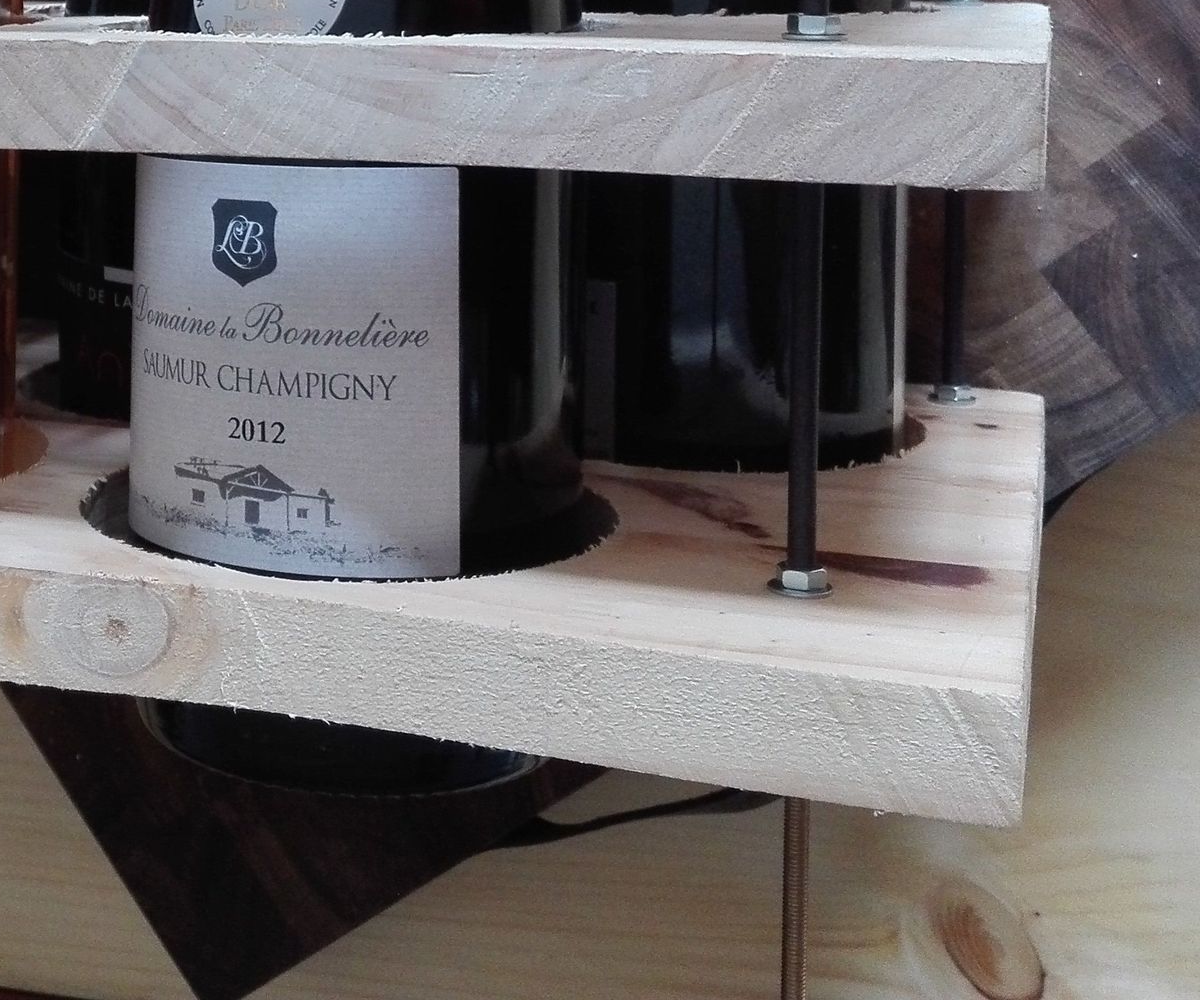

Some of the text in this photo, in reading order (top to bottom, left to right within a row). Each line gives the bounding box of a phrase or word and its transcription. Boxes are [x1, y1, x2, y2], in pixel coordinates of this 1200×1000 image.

[135, 283, 431, 348] Domaine la Bonnelière
[143, 347, 211, 389] SAUMUR
[217, 364, 399, 402] CHAMPIGNY
[227, 416, 286, 445] 2012
